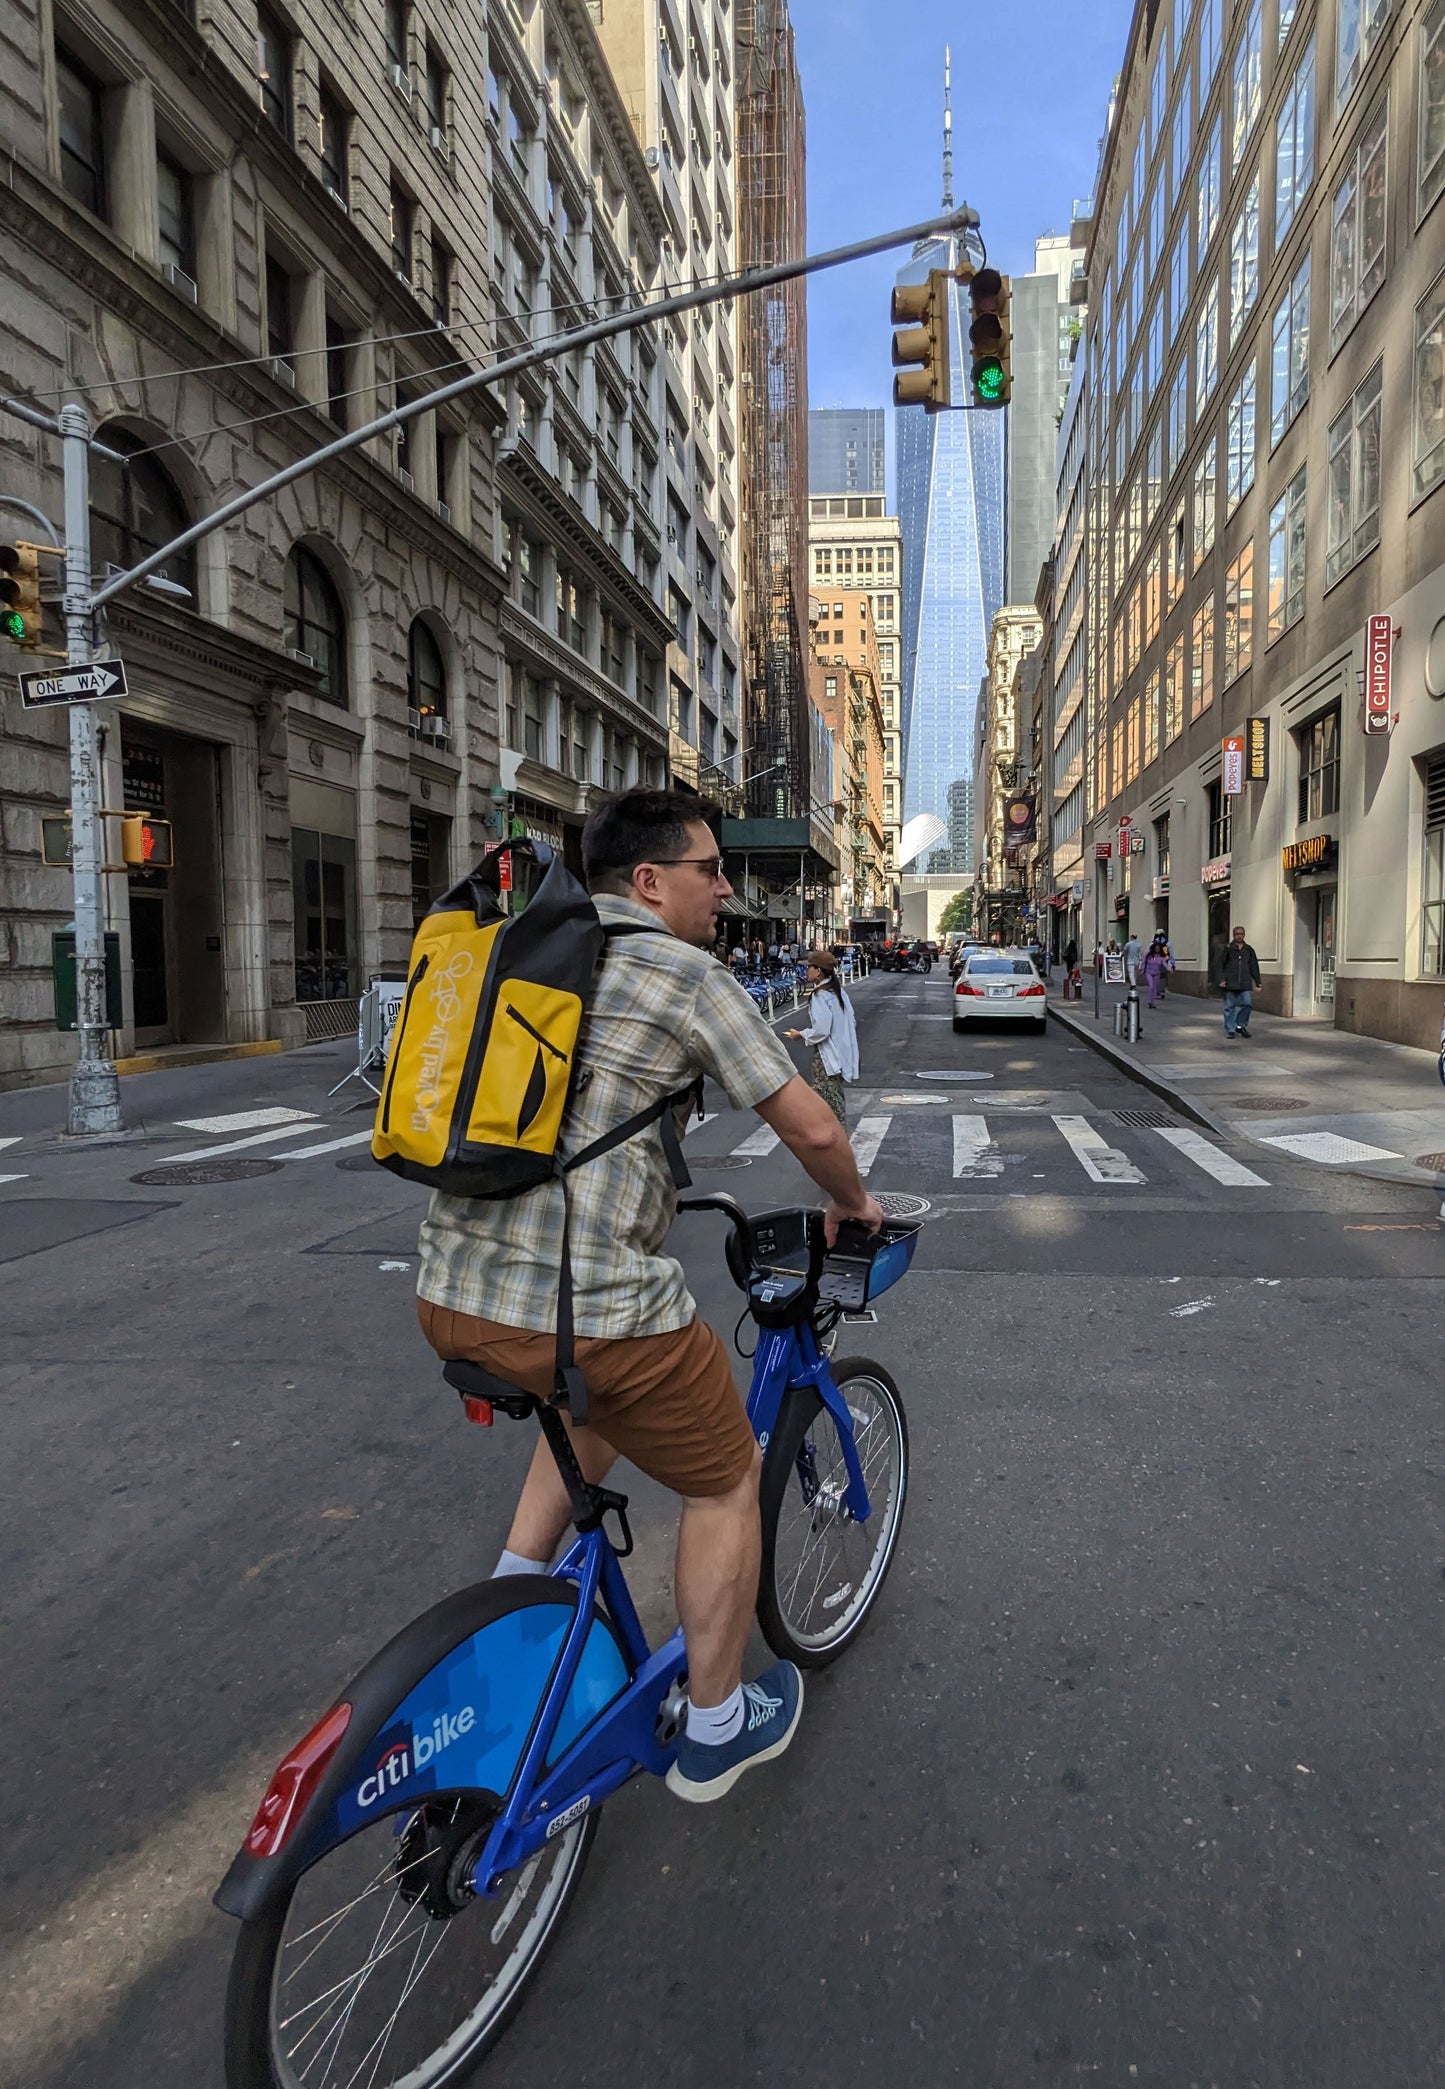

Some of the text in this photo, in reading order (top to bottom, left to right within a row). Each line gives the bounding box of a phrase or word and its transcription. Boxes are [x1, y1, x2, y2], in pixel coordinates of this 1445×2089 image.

[36, 673, 108, 695] ONE WAY
[1373, 620, 1388, 706] CHIPOTLE
[424, 1024, 448, 1049] by
[357, 1706, 475, 1807] citi bike
